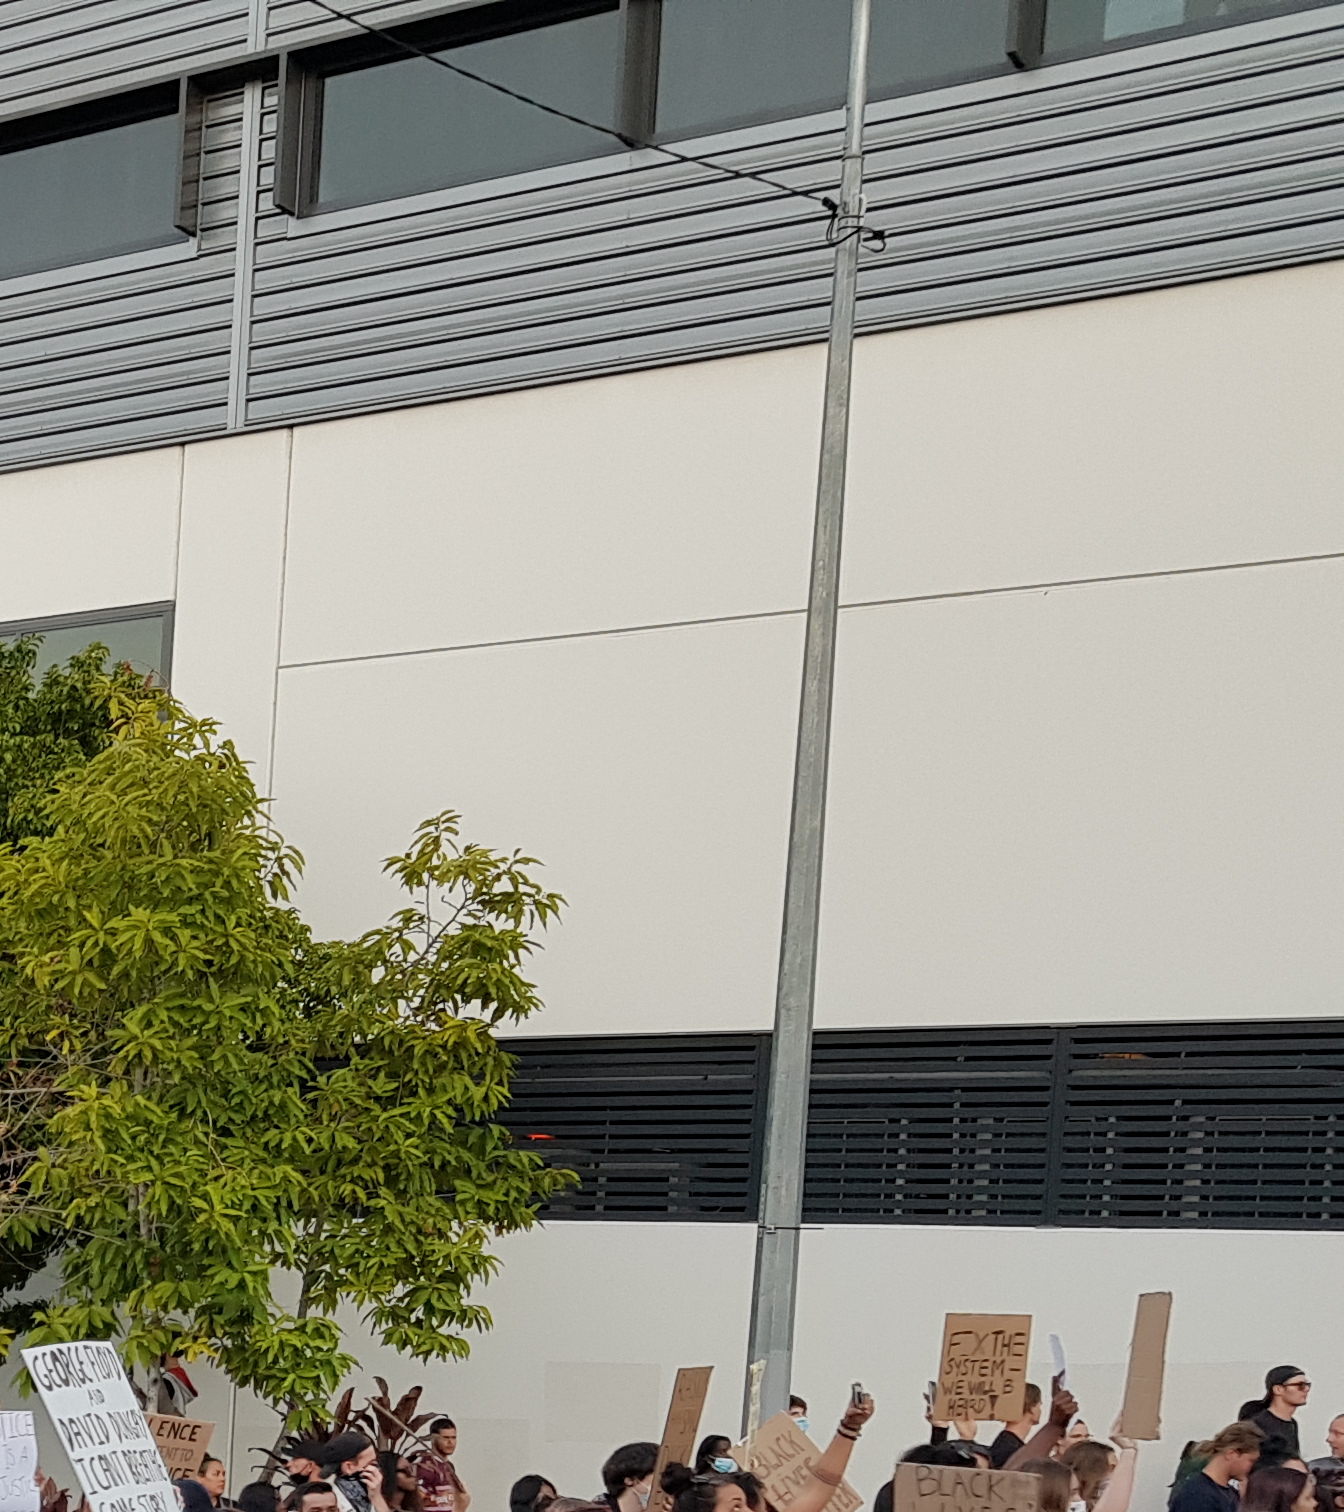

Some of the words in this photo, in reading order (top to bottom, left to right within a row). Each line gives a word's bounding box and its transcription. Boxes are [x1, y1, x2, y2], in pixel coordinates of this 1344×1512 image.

[991, 1329, 1026, 1357] THE
[32, 1344, 93, 1392] GEORGE
[83, 1344, 123, 1383] FLOYD
[941, 1379, 964, 1396] WE
[58, 1412, 111, 1453] DAVID
[915, 1465, 1007, 1503] BLACK
